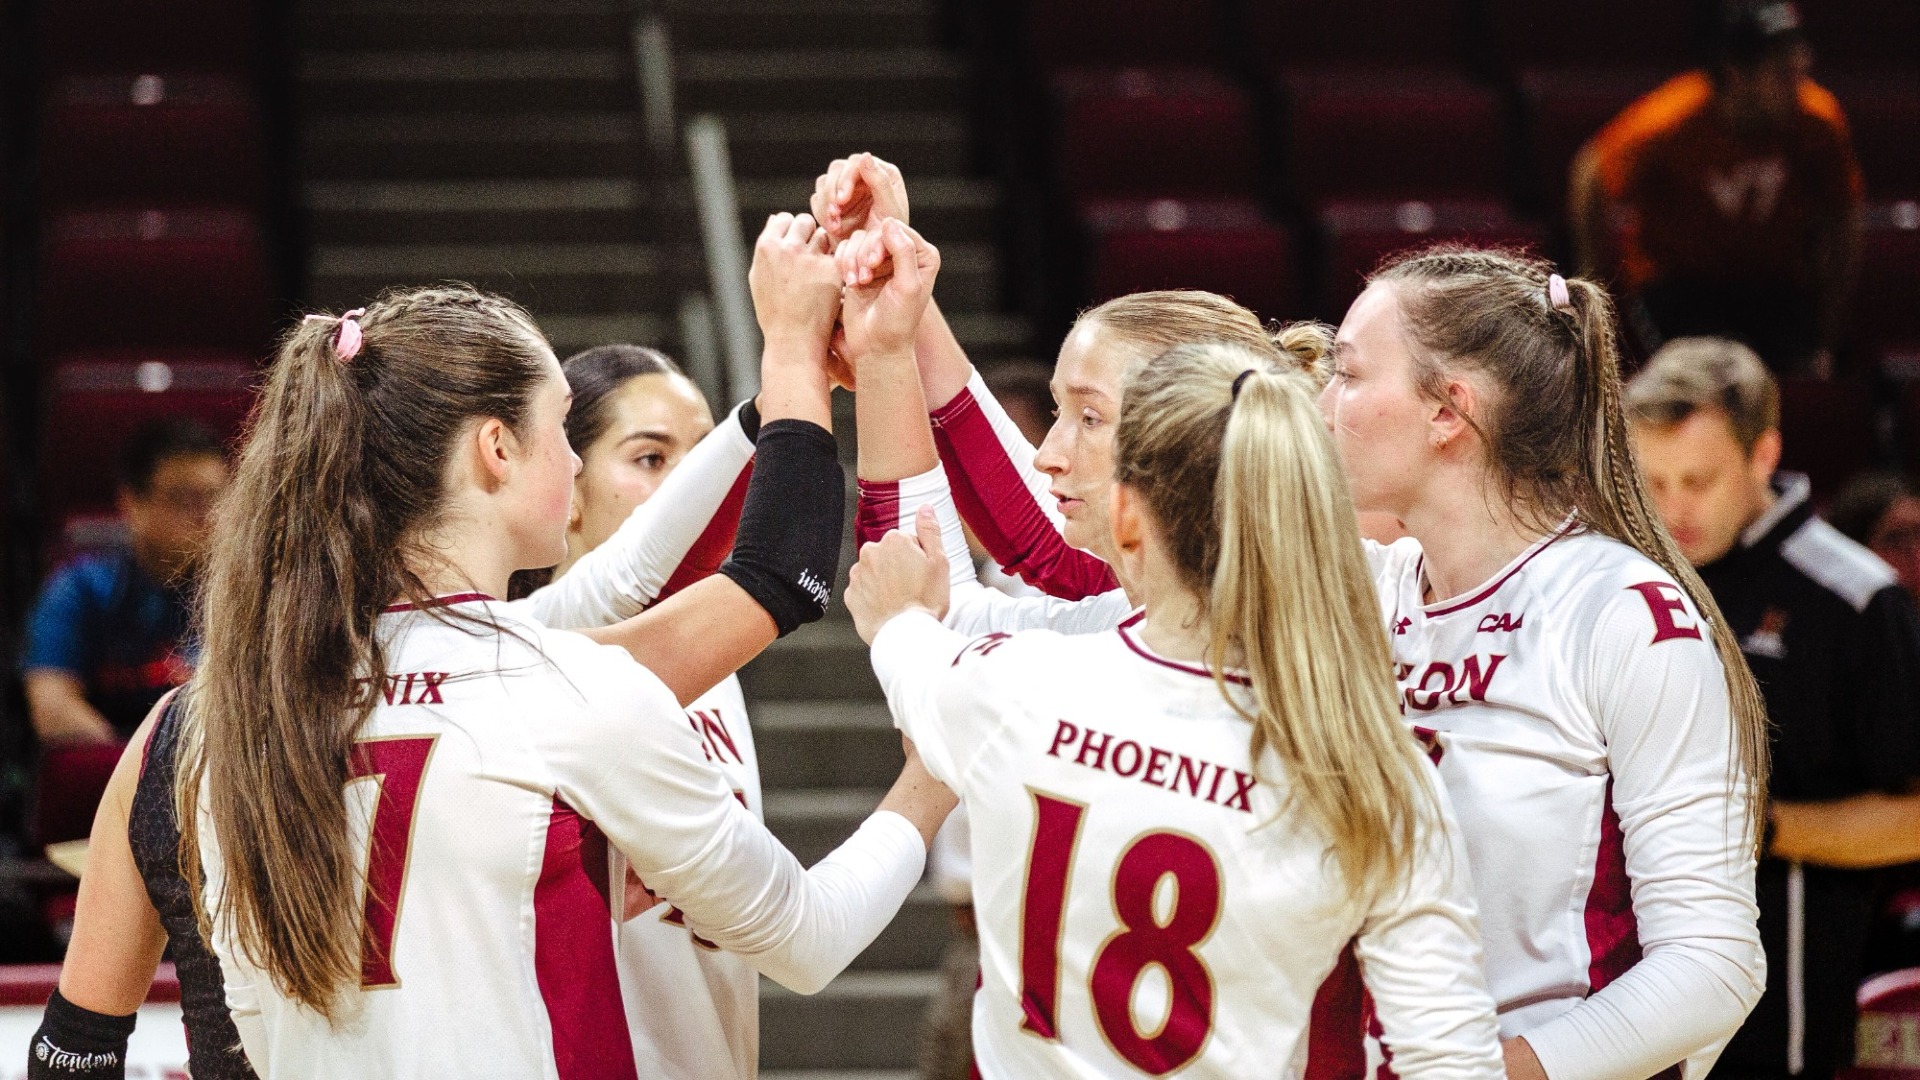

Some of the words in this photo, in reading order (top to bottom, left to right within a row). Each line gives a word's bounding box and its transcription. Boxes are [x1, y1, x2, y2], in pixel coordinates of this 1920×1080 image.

[1476, 612, 1525, 633] CAA
[1625, 580, 1702, 646] E
[344, 671, 450, 708] ENIX
[1046, 719, 1258, 814] PHOENIX
[344, 732, 443, 992] 7
[1019, 784, 1227, 1079] 18
[42, 1035, 119, 1073] Tandem
